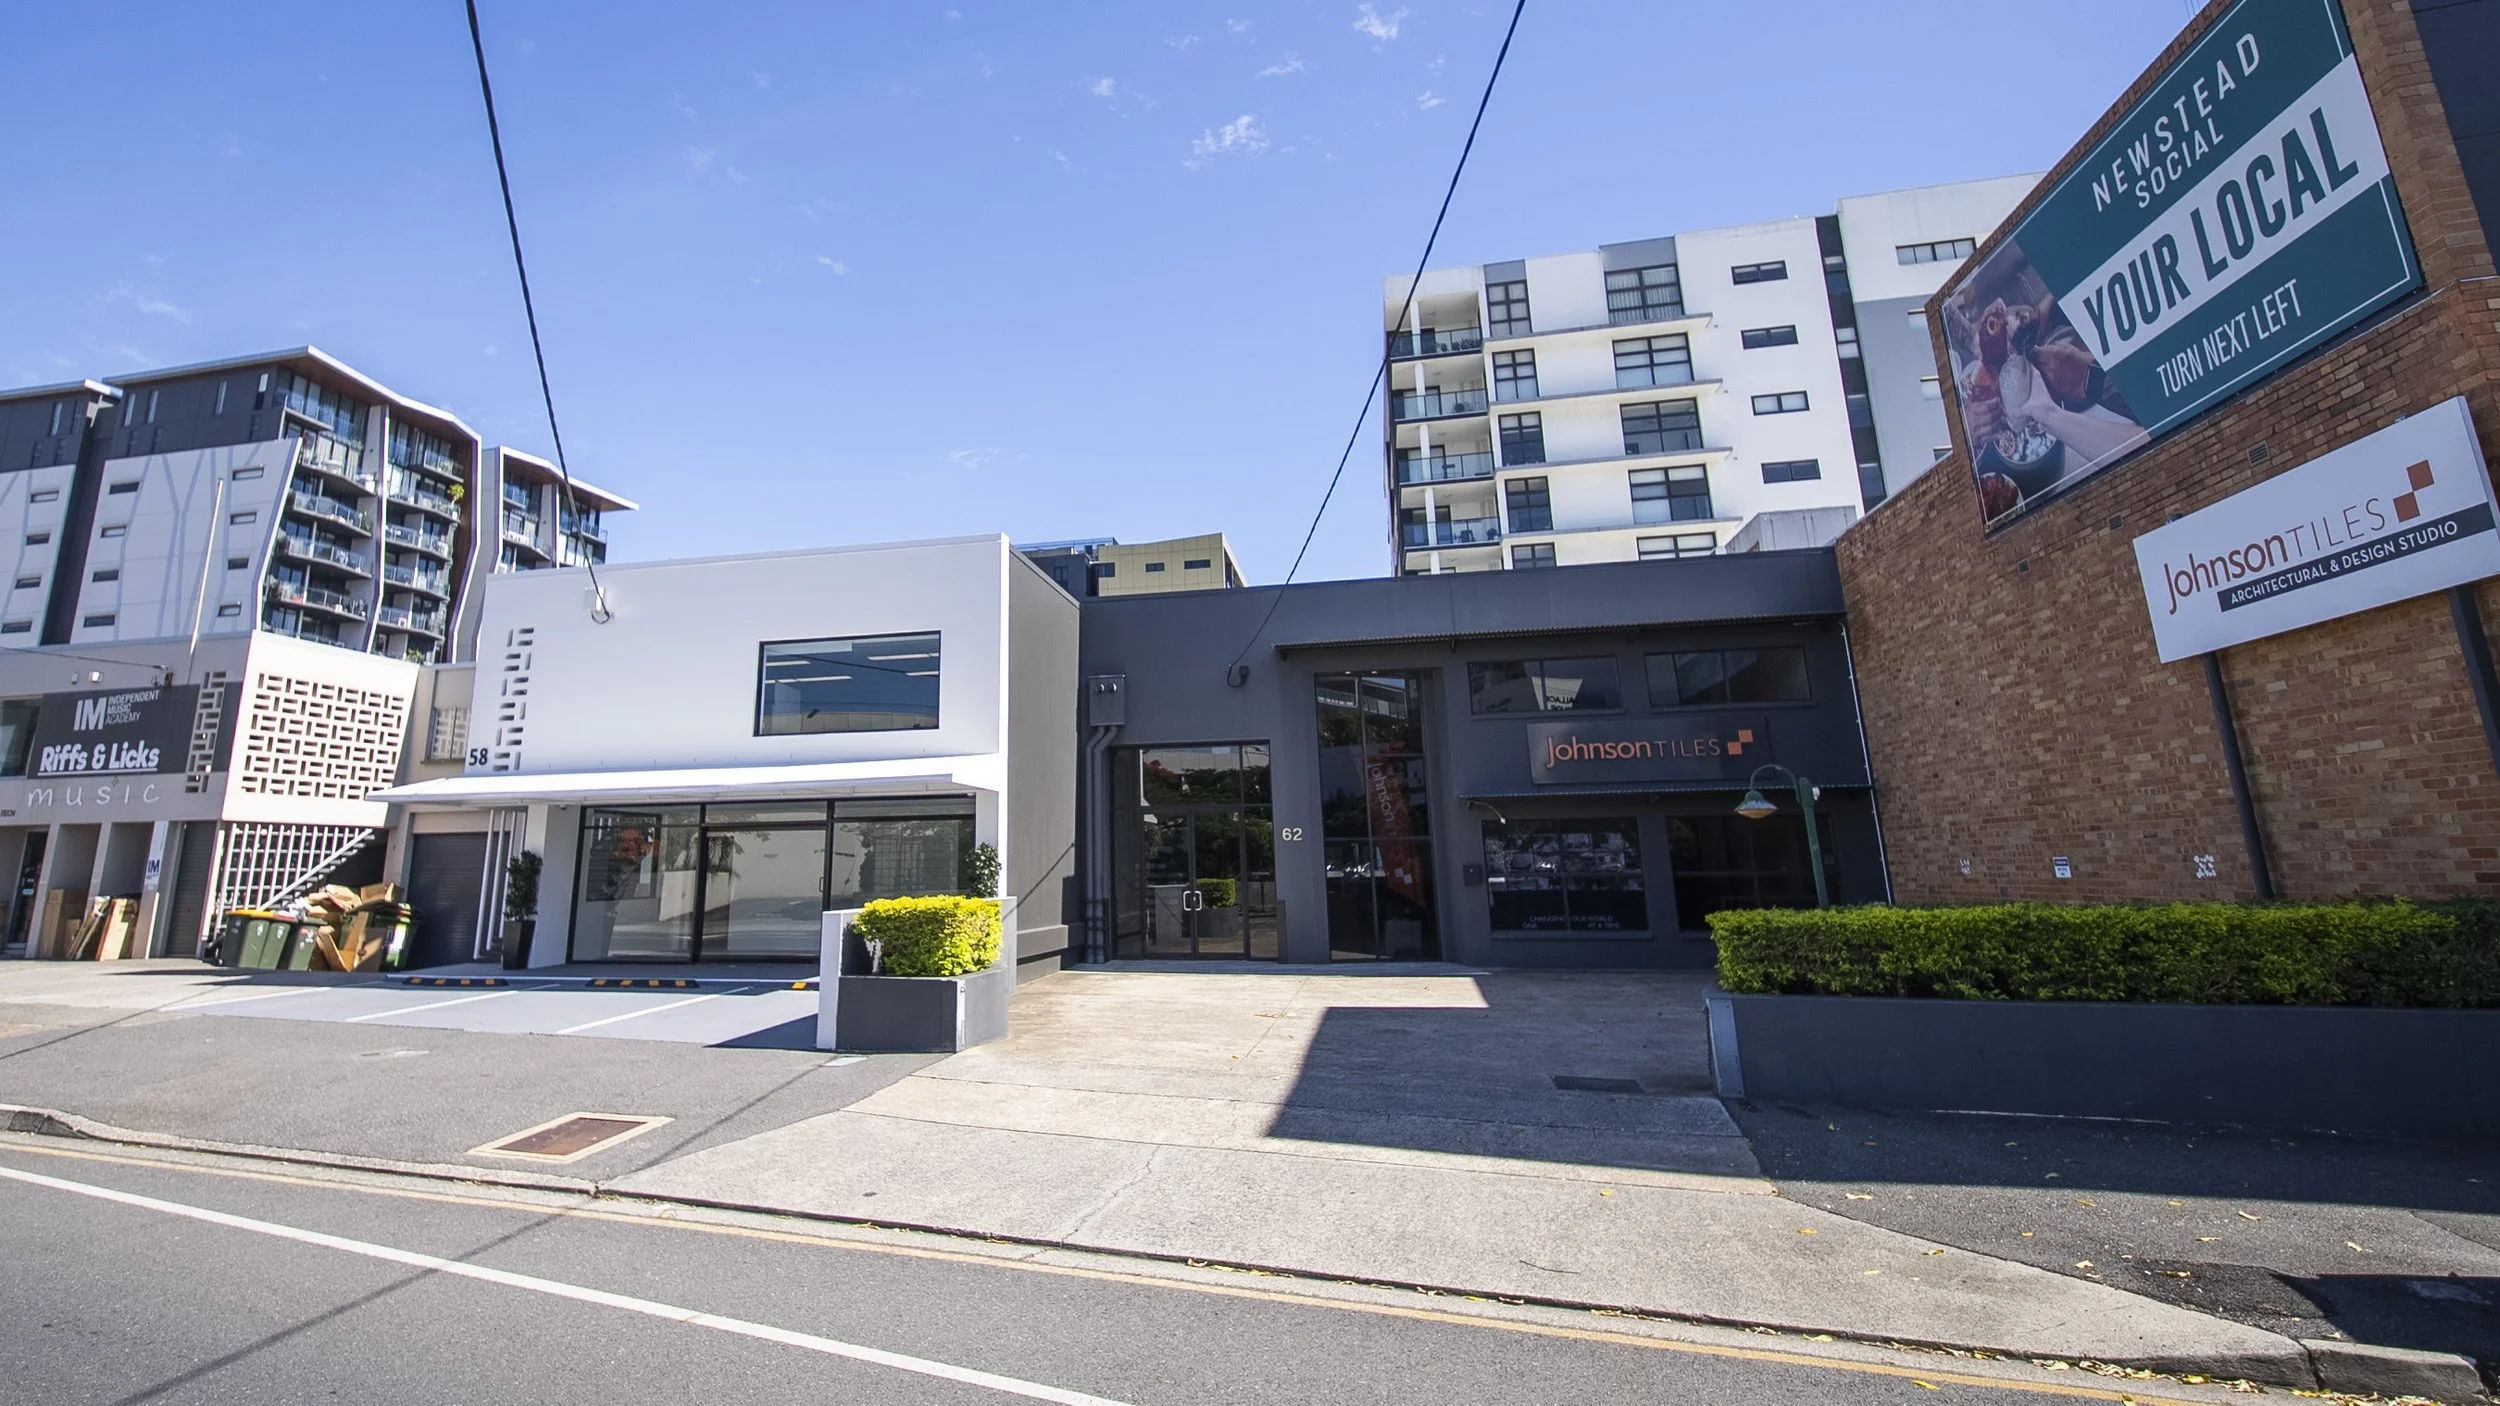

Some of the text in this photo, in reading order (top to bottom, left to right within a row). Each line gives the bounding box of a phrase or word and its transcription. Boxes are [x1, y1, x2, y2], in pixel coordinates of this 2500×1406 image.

[2092, 33, 2260, 213] NEWSTEAD
[2134, 117, 2224, 208] SOCIAL
[2082, 106, 2360, 357] YOUR LOCAL
[2156, 278, 2302, 398] TURN NEXT LEFT
[2230, 520, 2459, 605] ARCHITECTURAL & DESIGN STUDIO
[73, 697, 107, 731] IM
[106, 702, 132, 715] MUSIC
[107, 690, 160, 705] INDEPENDENT
[39, 740, 160, 772] Riffs & Licks
[468, 747, 489, 766] 58
[1282, 827, 1303, 841] 62
